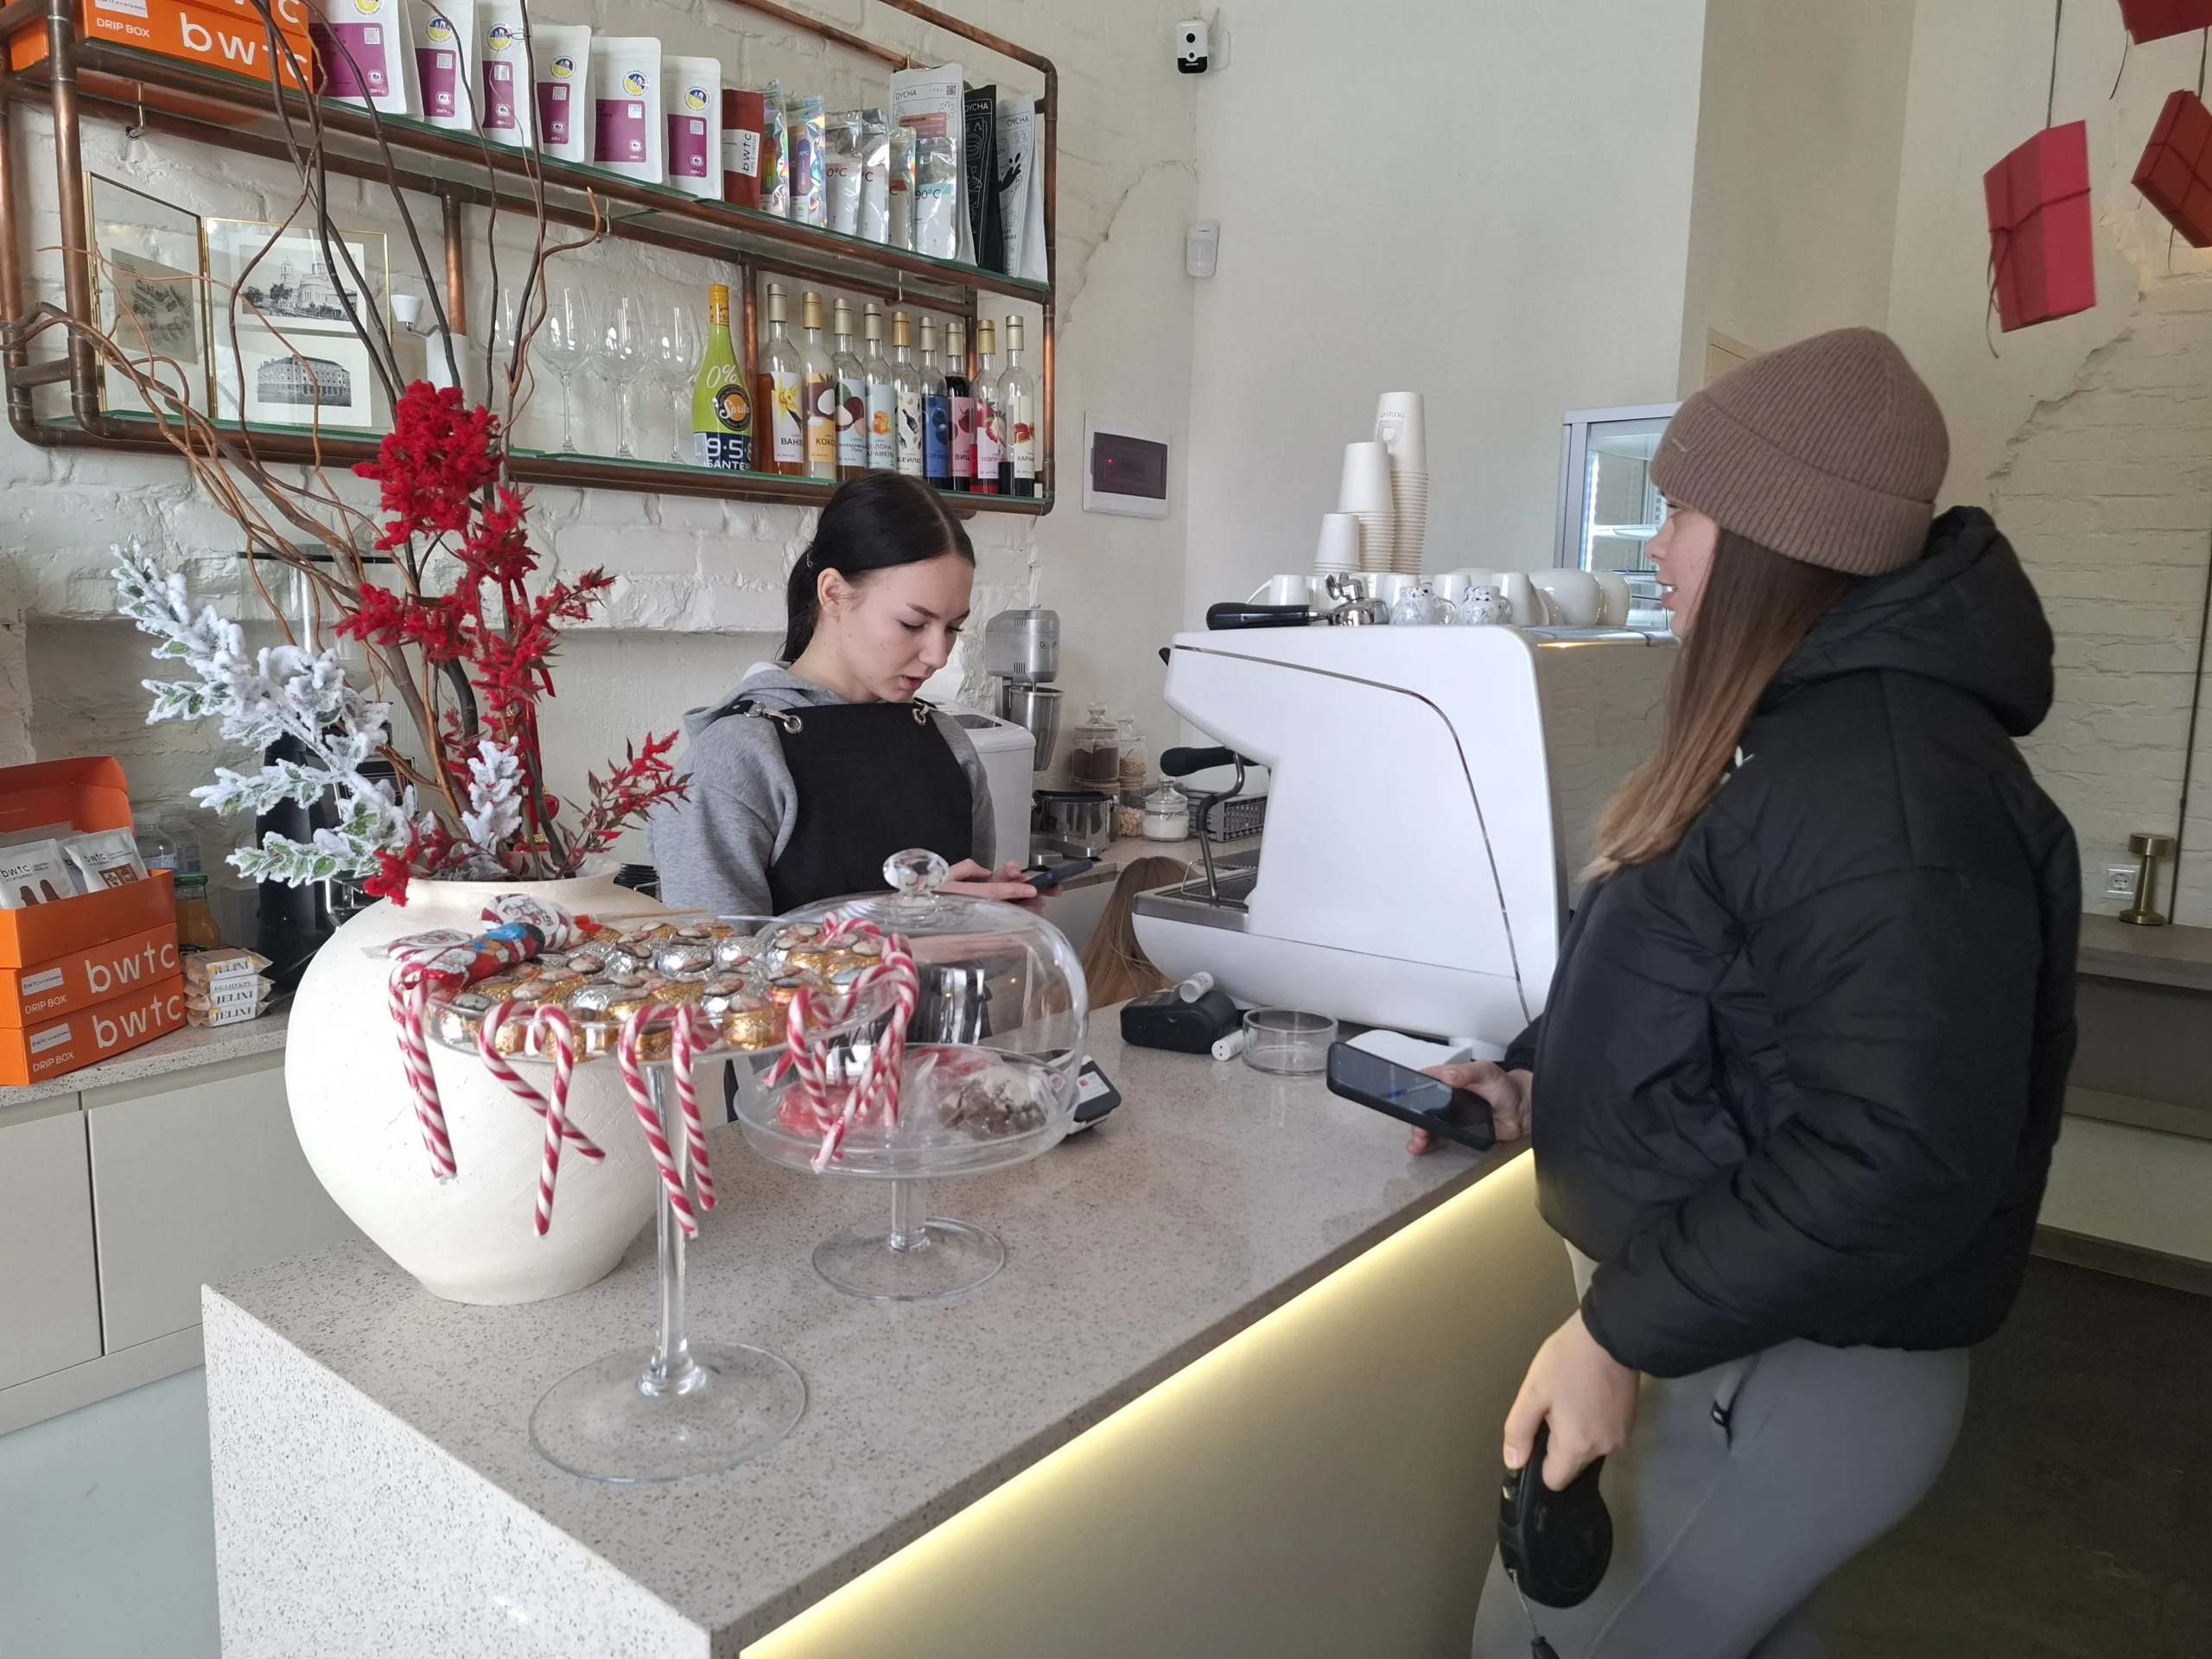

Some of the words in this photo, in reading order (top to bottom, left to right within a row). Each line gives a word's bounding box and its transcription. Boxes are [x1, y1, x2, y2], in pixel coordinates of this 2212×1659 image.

[96, 17, 124, 31] DRIP
[125, 25, 150, 38] BOX
[964, 102, 988, 112] OYCHA
[1007, 115, 1029, 127] OYCHA
[741, 133, 752, 172] bwtc
[915, 189, 941, 200] 90°C
[706, 364, 737, 389] 0%
[0, 864, 31, 878] bwtc
[85, 941, 175, 994] bwtc
[25, 1001, 47, 1014] DRIP
[48, 995, 67, 1007] BOX
[217, 990, 253, 1005] JELINI
[92, 994, 181, 1049] bwtc
[214, 1007, 251, 1021] JELINI
[33, 1058, 54, 1072] DRIP
[55, 1051, 74, 1064] BOX
